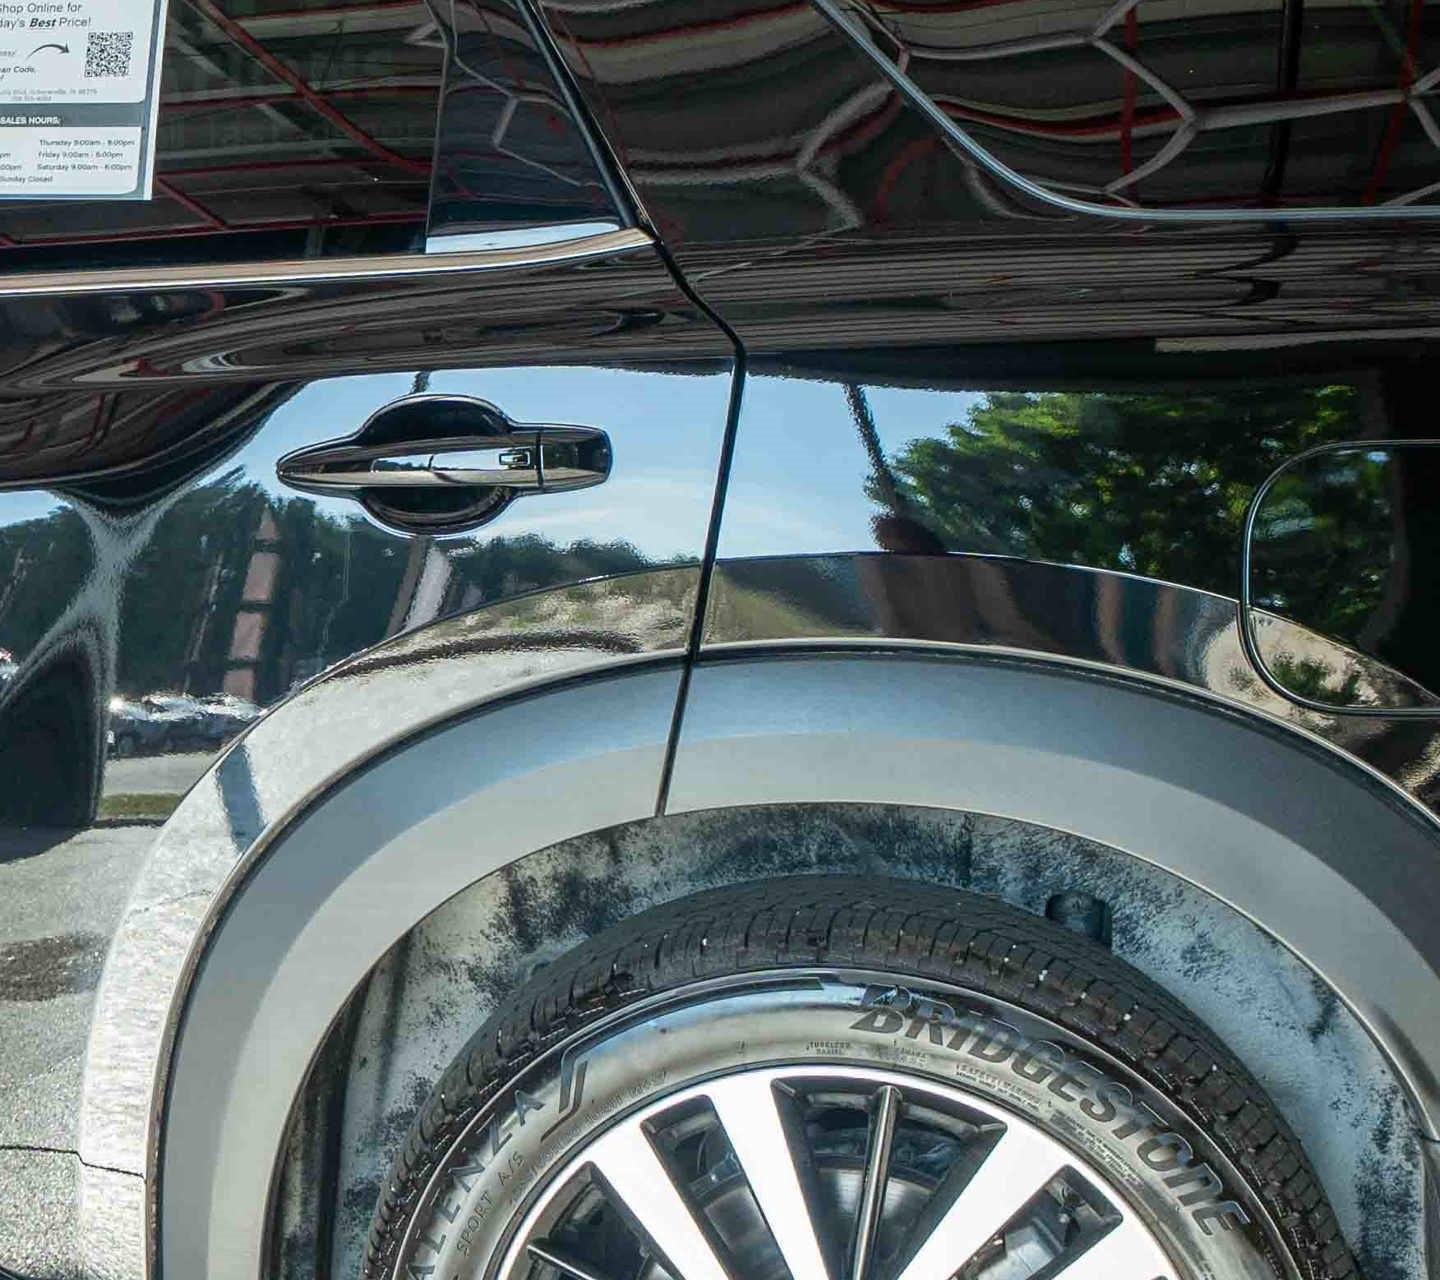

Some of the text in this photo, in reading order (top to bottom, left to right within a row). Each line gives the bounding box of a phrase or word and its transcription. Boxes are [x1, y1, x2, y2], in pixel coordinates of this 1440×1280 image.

[27, 2, 63, 13] Online
[67, 2, 82, 12] for
[29, 17, 56, 28] Best
[58, 17, 92, 27] Price!
[0, 116, 27, 125] SALES
[850, 983, 1251, 1237] BRIDGESTONE
[456, 1151, 527, 1257] SPORT A/S
